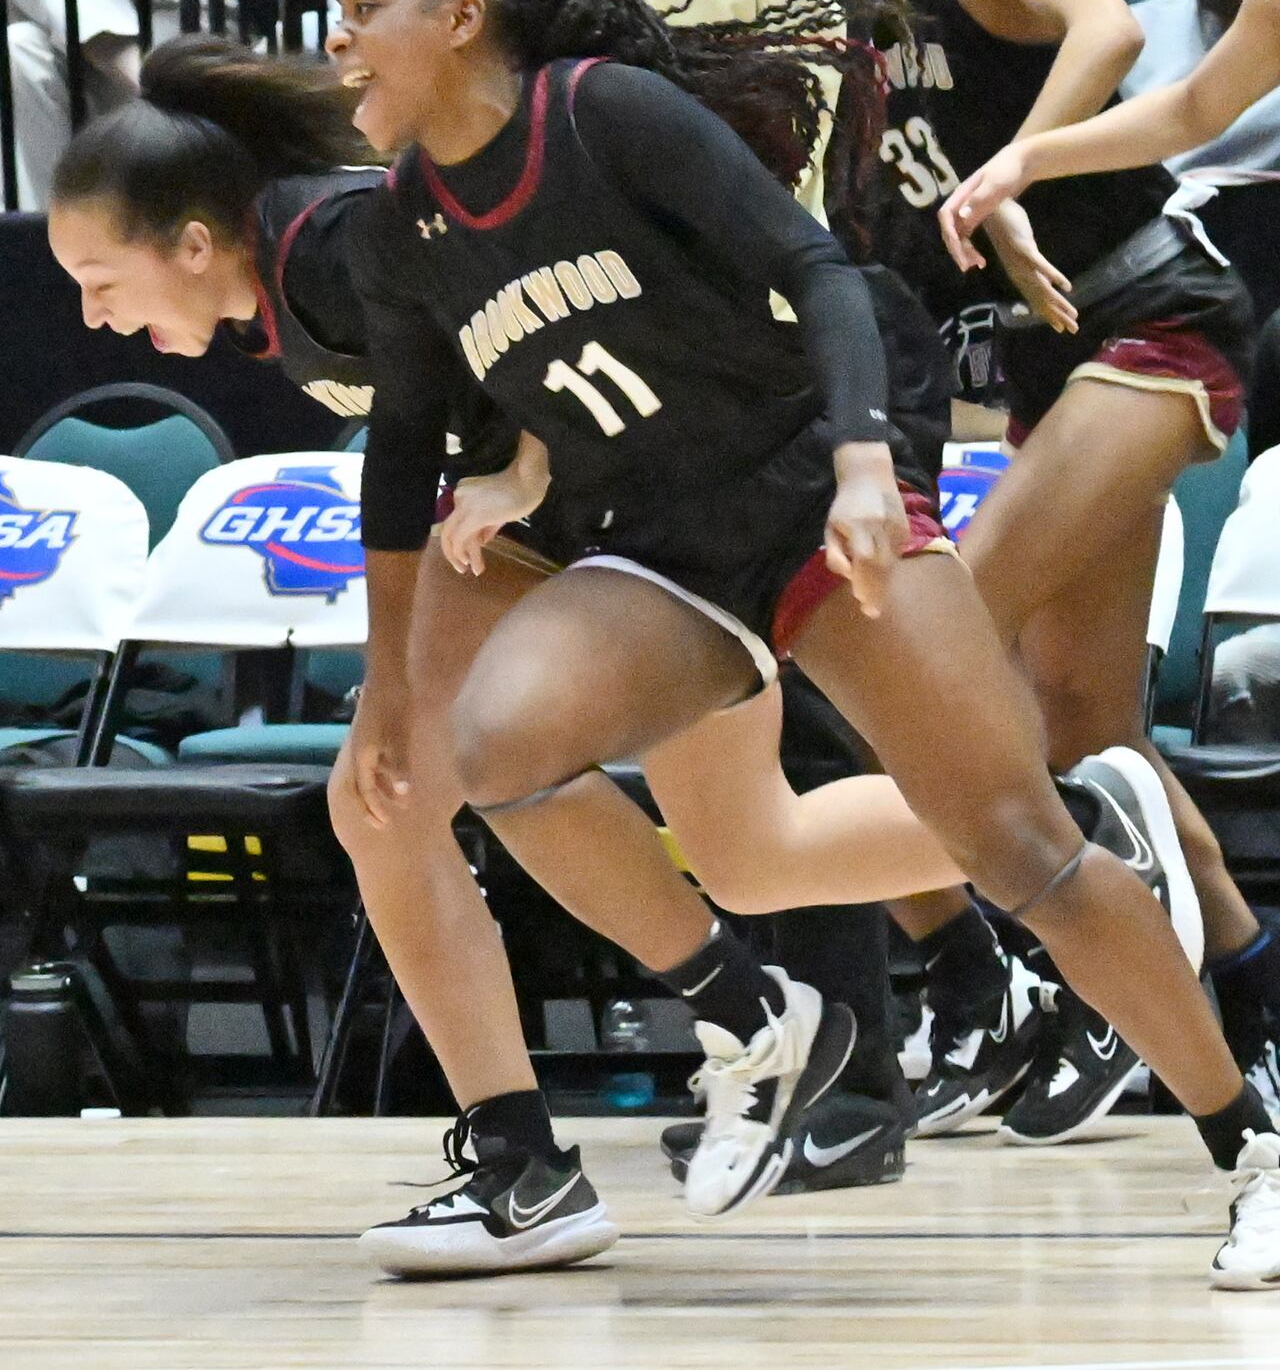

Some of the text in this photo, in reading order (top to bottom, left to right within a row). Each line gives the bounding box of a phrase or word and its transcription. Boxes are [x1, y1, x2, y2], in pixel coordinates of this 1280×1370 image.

[458, 250, 643, 382] BROOKWOOD
[542, 340, 663, 438] 11
[203, 505, 362, 542] GHS
